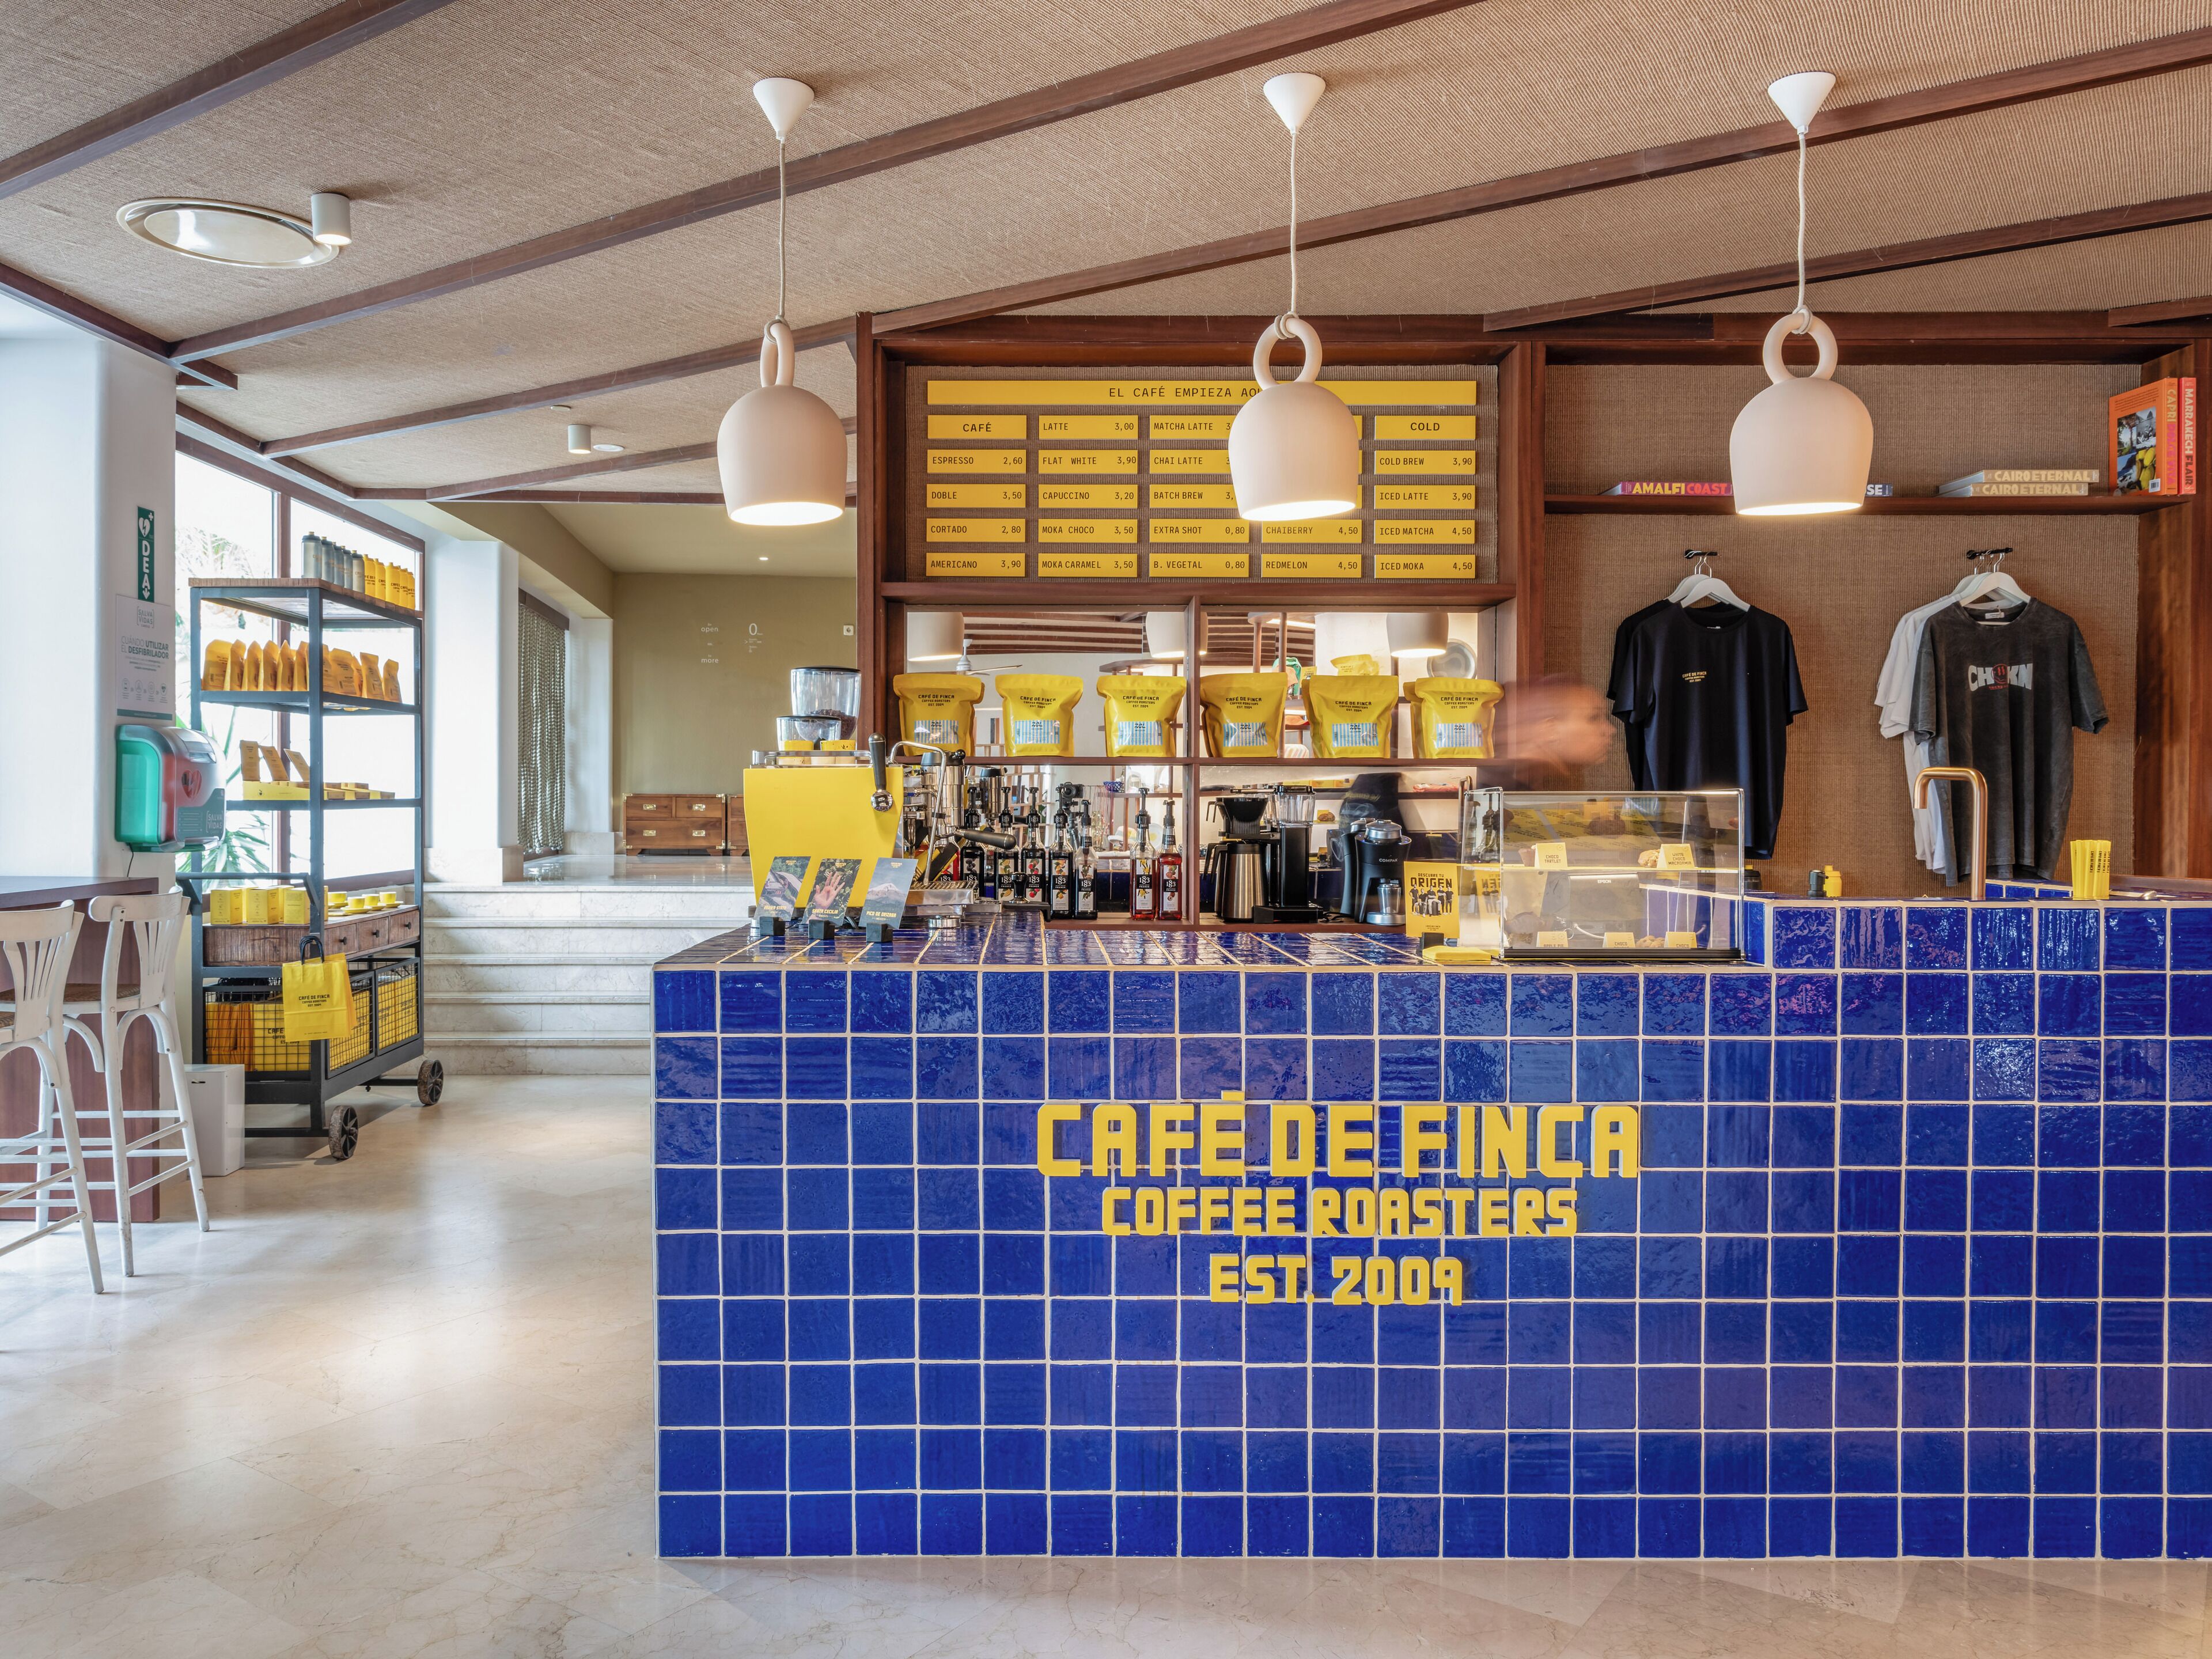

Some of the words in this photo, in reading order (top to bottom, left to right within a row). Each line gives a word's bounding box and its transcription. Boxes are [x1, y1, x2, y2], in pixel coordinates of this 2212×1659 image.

[1109, 388, 1124, 397] EL
[1133, 385, 1165, 397] CAFÉ
[1175, 387, 1232, 397] EMPIEZA
[2166, 389, 2176, 422] CAPRI
[2184, 388, 2194, 454] MARRAKECH
[963, 422, 991, 433] CAFÉ
[1043, 422, 1069, 431] LATTE
[1115, 422, 1134, 431] 3,00
[1154, 422, 1185, 431] MATCHA
[1188, 422, 1213, 431] LATTE
[1410, 422, 1440, 431] COLD
[933, 456, 974, 465] ESPRESSO
[1003, 456, 1023, 465] 2,60
[1043, 457, 1062, 465] FLAT
[1071, 457, 1097, 465] WHITE
[1117, 456, 1137, 465] 3,90
[1154, 457, 1175, 465] CHAI
[1178, 457, 1203, 465] LATTE
[1380, 457, 1400, 465] COLD
[1403, 457, 1424, 465] BREW
[1453, 457, 1472, 466] 3,90
[2185, 455, 2194, 486] FLAIR
[1994, 471, 2031, 482] CAIRO
[2032, 471, 2090, 481] ETERNAL
[1632, 483, 1685, 494] AMALFI
[1686, 483, 1728, 494] COAST
[1982, 484, 2018, 495] CAIRO
[2020, 484, 2079, 495] ETERNAL
[931, 491, 957, 499] DOBLE
[1002, 491, 1022, 500] 3,50
[1043, 491, 1089, 500] CAPUCCINO
[1115, 491, 1134, 501] 3,20
[1154, 491, 1179, 499] BATCH
[1182, 491, 1203, 499] BREW
[1380, 493, 1400, 501] ICED
[1403, 493, 1429, 501] LATTE
[1452, 493, 1472, 501] 3,90
[931, 525, 967, 534] CORTADO
[1042, 525, 1063, 534] MOKA
[1068, 525, 1094, 534] CHOCO
[1154, 526, 1179, 534] EXTRA
[1182, 526, 1202, 534] SHOT
[1225, 526, 1245, 535] 0,80
[1266, 526, 1313, 535] CHAIBERRY
[1338, 527, 1358, 536] 4,50
[1380, 527, 1400, 536] ICED
[1403, 527, 1434, 536] MATCHA
[1452, 527, 1472, 536] 4,50
[142, 540, 151, 589] DEA
[930, 559, 977, 569] AMERICANO
[1001, 559, 1021, 569] 3,90
[1042, 560, 1063, 569] MOKA
[1065, 560, 1101, 569] CARAMEL
[1114, 560, 1134, 569] 3,50
[1154, 560, 1162, 569] B.
[1166, 560, 1203, 569] VEGETAL
[1225, 560, 1245, 570] 0,80
[1266, 560, 1308, 570] REDMELON
[1338, 561, 1358, 570] 4,50
[1381, 562, 1401, 570] ICED
[1403, 562, 1424, 570] MOKA
[1453, 562, 1472, 571] 4,50
[138, 609, 153, 618] SALVA
[139, 616, 153, 624] VIDAS
[121, 635, 144, 647] CUÁNDO
[145, 640, 169, 652] UTILIZAR
[121, 644, 127, 653] EL
[128, 646, 169, 660] DESFIBRILADOR
[1410, 877, 1452, 888] ORIGEN
[1037, 1090, 1246, 1178] CAFÉ
[1270, 1103, 1374, 1178] DE
[1401, 1104, 1639, 1179] FINCA
[1101, 1187, 1296, 1236] COFFEE
[1310, 1187, 1578, 1238] ROASTERS
[1209, 1252, 1315, 1304] EST.
[1331, 1255, 1464, 1306] 2009
